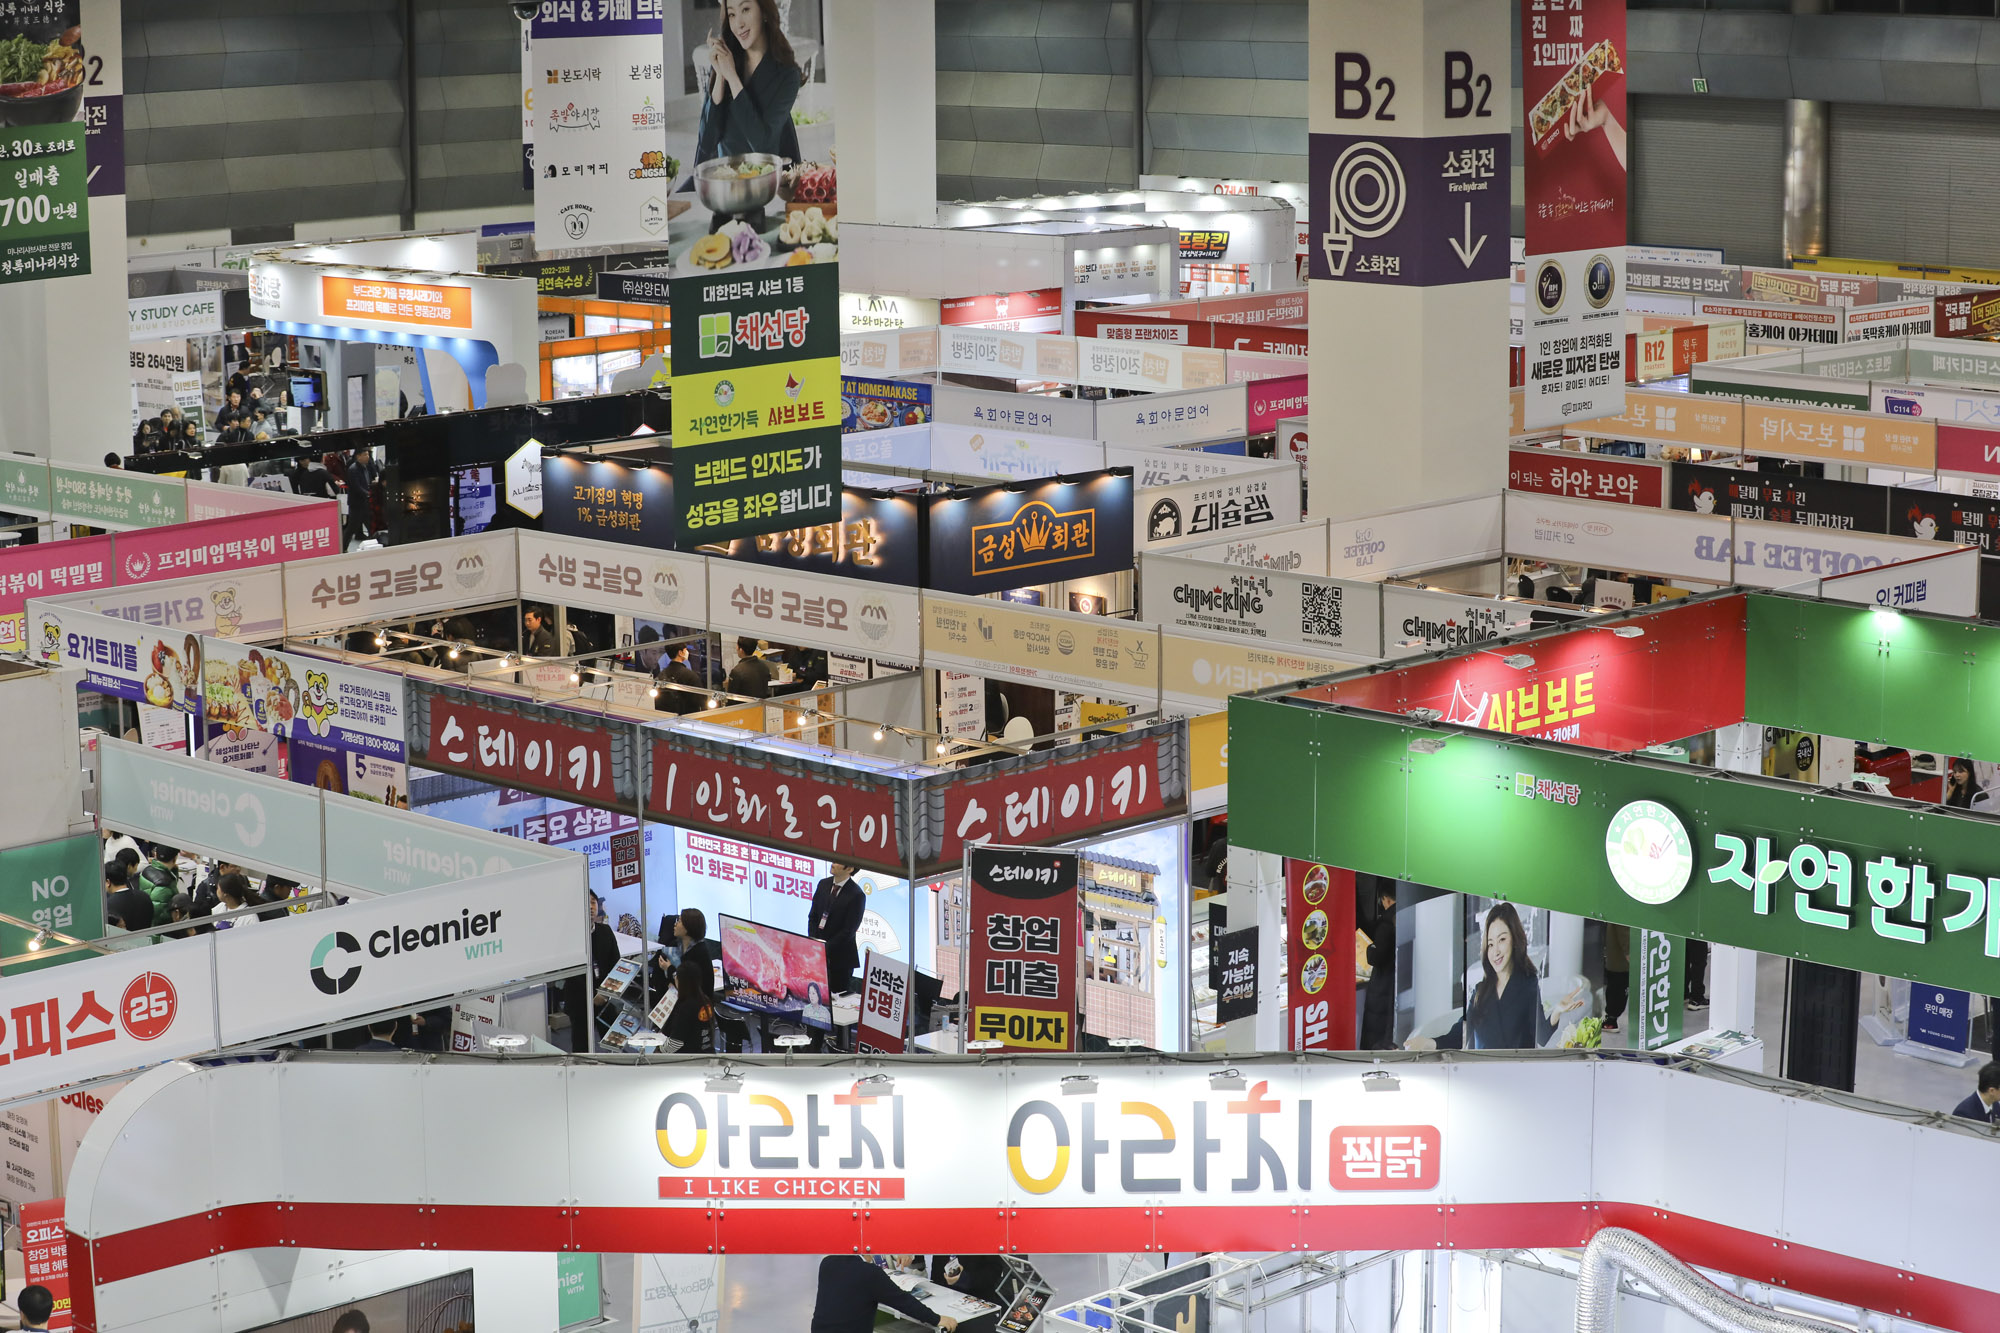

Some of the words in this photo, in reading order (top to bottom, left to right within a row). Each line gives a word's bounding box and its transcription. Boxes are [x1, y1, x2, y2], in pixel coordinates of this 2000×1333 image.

[541, 0, 576, 23] 외식
[581, 3, 593, 22] &
[599, 0, 632, 21] 카페
[1531, 15, 1547, 38] 진
[1569, 15, 1584, 38] 짜
[1533, 42, 1583, 66] 1인피자
[561, 67, 602, 83] 본도시락
[1334, 52, 1396, 121] B2
[1444, 50, 1492, 119] B2
[550, 107, 600, 123] 족발야시장
[12, 139, 44, 158] 30초
[46, 139, 76, 152] 조리로
[1441, 148, 1495, 179] 소화전
[14, 165, 60, 189] 일매출
[1449, 183, 1463, 193] Fire
[1463, 181, 1488, 192] hydrant
[2, 253, 80, 275] 청록미나리식당
[1355, 255, 1400, 276] 소화전
[353, 285, 382, 298] 부드러운
[383, 286, 398, 299] 가을
[398, 288, 443, 304] 무청시래기와
[703, 281, 754, 302] 대한민국
[757, 278, 783, 297] 샤브
[785, 276, 804, 294] 1등
[140, 306, 178, 321] STUDY
[182, 302, 215, 317] CAFE
[346, 299, 374, 312] 프리미엄
[398, 303, 413, 316] 만든
[414, 304, 452, 320] 명품감자탕
[735, 306, 810, 350] 채선당
[1106, 328, 1132, 341] 맞춤형
[1135, 328, 1178, 342] 프랜차이즈
[1788, 326, 1838, 345] 아카데미
[1863, 322, 1901, 341] 뚝딱홈케어
[1902, 319, 1931, 336] 아카데미
[1539, 342, 1551, 356] 1인
[1552, 337, 1578, 354] 창업에
[1580, 332, 1613, 350] 최적화된
[1644, 340, 1665, 363] R12
[147, 354, 184, 373] 264만원
[1531, 359, 1563, 382] 새로운
[1565, 355, 1597, 377] 피자집
[1599, 350, 1620, 370] 탄생
[847, 382, 857, 394] AT
[858, 382, 918, 400] HOMEMAKASE
[1541, 380, 1563, 395] 혼자도!
[1565, 377, 1587, 391] 같이도!
[1589, 375, 1610, 388] 어디도!
[973, 406, 1052, 427] 육회야문연어
[1136, 404, 1209, 426] 육회야문연어
[1572, 400, 1593, 413] 피자먹다
[1893, 405, 1910, 415] C114
[689, 409, 759, 436] 자연한가득
[768, 401, 825, 427] 샤브보트
[694, 456, 748, 487] 브랜드
[751, 445, 822, 480] 인지도가
[1194, 486, 1223, 502] 프리미엄
[1227, 485, 1242, 497] 김치
[1246, 481, 1267, 494] 삼겹살
[1510, 471, 1520, 484] 이
[1522, 471, 1544, 487] 되는
[1550, 467, 1592, 498] 하얀
[1594, 474, 1639, 504] 보약
[1728, 484, 1759, 501] 배달비
[1762, 487, 1782, 503] 무료
[1786, 491, 1806, 507] 치킨
[572, 485, 617, 505] 고기집의
[621, 485, 644, 511] 혁명
[686, 497, 739, 529] 성공을
[743, 483, 833, 520] 좌우합니다
[576, 506, 593, 523] 1%
[595, 509, 642, 533] 금성회관
[1952, 510, 1984, 528] 배달비
[158, 535, 275, 571] 프리미엄떡볶이
[282, 527, 330, 552] 떡밀밀
[978, 529, 1017, 563] 금성
[1051, 518, 1091, 551] 회관
[51, 562, 103, 588] 떡밀밀
[1876, 588, 1890, 607] 오!
[1893, 579, 1927, 606] 커피랩
[68, 633, 138, 672] 요거트퍼플
[1302, 637, 1343, 647] www.chimcking.com
[339, 683, 391, 703] #요거트아이스크림
[1488, 671, 1595, 733] 샤브보트
[340, 696, 374, 712] #그릭요거트
[375, 703, 398, 717] #츄러스
[369, 715, 386, 727] #커피
[240, 741, 260, 752] 나타난
[340, 729, 364, 747] 가맹상담
[365, 735, 400, 754] 1800-8084
[440, 715, 600, 791] 스테이키
[1537, 779, 1581, 806] 채선당
[666, 763, 888, 851] 1인화로구이
[957, 764, 1147, 849] 스테이키
[525, 815, 568, 845] 주요
[573, 808, 612, 837] 상권
[583, 840, 609, 855] 인천시
[613, 834, 638, 851] 무이자
[616, 847, 635, 862] 대출
[690, 835, 721, 854] 대한민국
[723, 841, 739, 856] 최초
[761, 850, 792, 869] 고객님을
[794, 858, 812, 874] 위한
[623, 863, 635, 876] 1억
[685, 854, 704, 874] 1인
[772, 872, 814, 901] 고깃집
[989, 864, 1059, 885] 스테이키
[1098, 867, 1136, 888] 스테이키
[32, 875, 69, 901] NO
[32, 903, 73, 931] 영업
[369, 908, 502, 959] Cleanier
[986, 913, 1060, 954] 창업
[465, 939, 503, 961] WITH
[1228, 947, 1249, 966] 지속
[869, 966, 905, 996] 선착순
[985, 959, 1059, 999] 대출
[1222, 963, 1255, 986] 가능한
[867, 987, 893, 1019] 5명
[1222, 981, 1254, 1004] 수익성
[131, 992, 168, 1023] 25
[1924, 1003, 1938, 1015] 무인
[1939, 1007, 1953, 1019] 매장
[979, 1012, 1064, 1043] 무이자
[655, 1082, 905, 1170] 아라치
[1007, 1080, 1312, 1194] 아라치
[1342, 1136, 1428, 1180] 찜닭
[684, 1179, 694, 1196] I
[708, 1179, 760, 1196] LIKE
[774, 1179, 882, 1196] CHICKEN
[26, 1225, 64, 1244] 오피스
[28, 1248, 49, 1262] 창업
[29, 1261, 50, 1275] 특별
[567, 1285, 585, 1295] WITH
